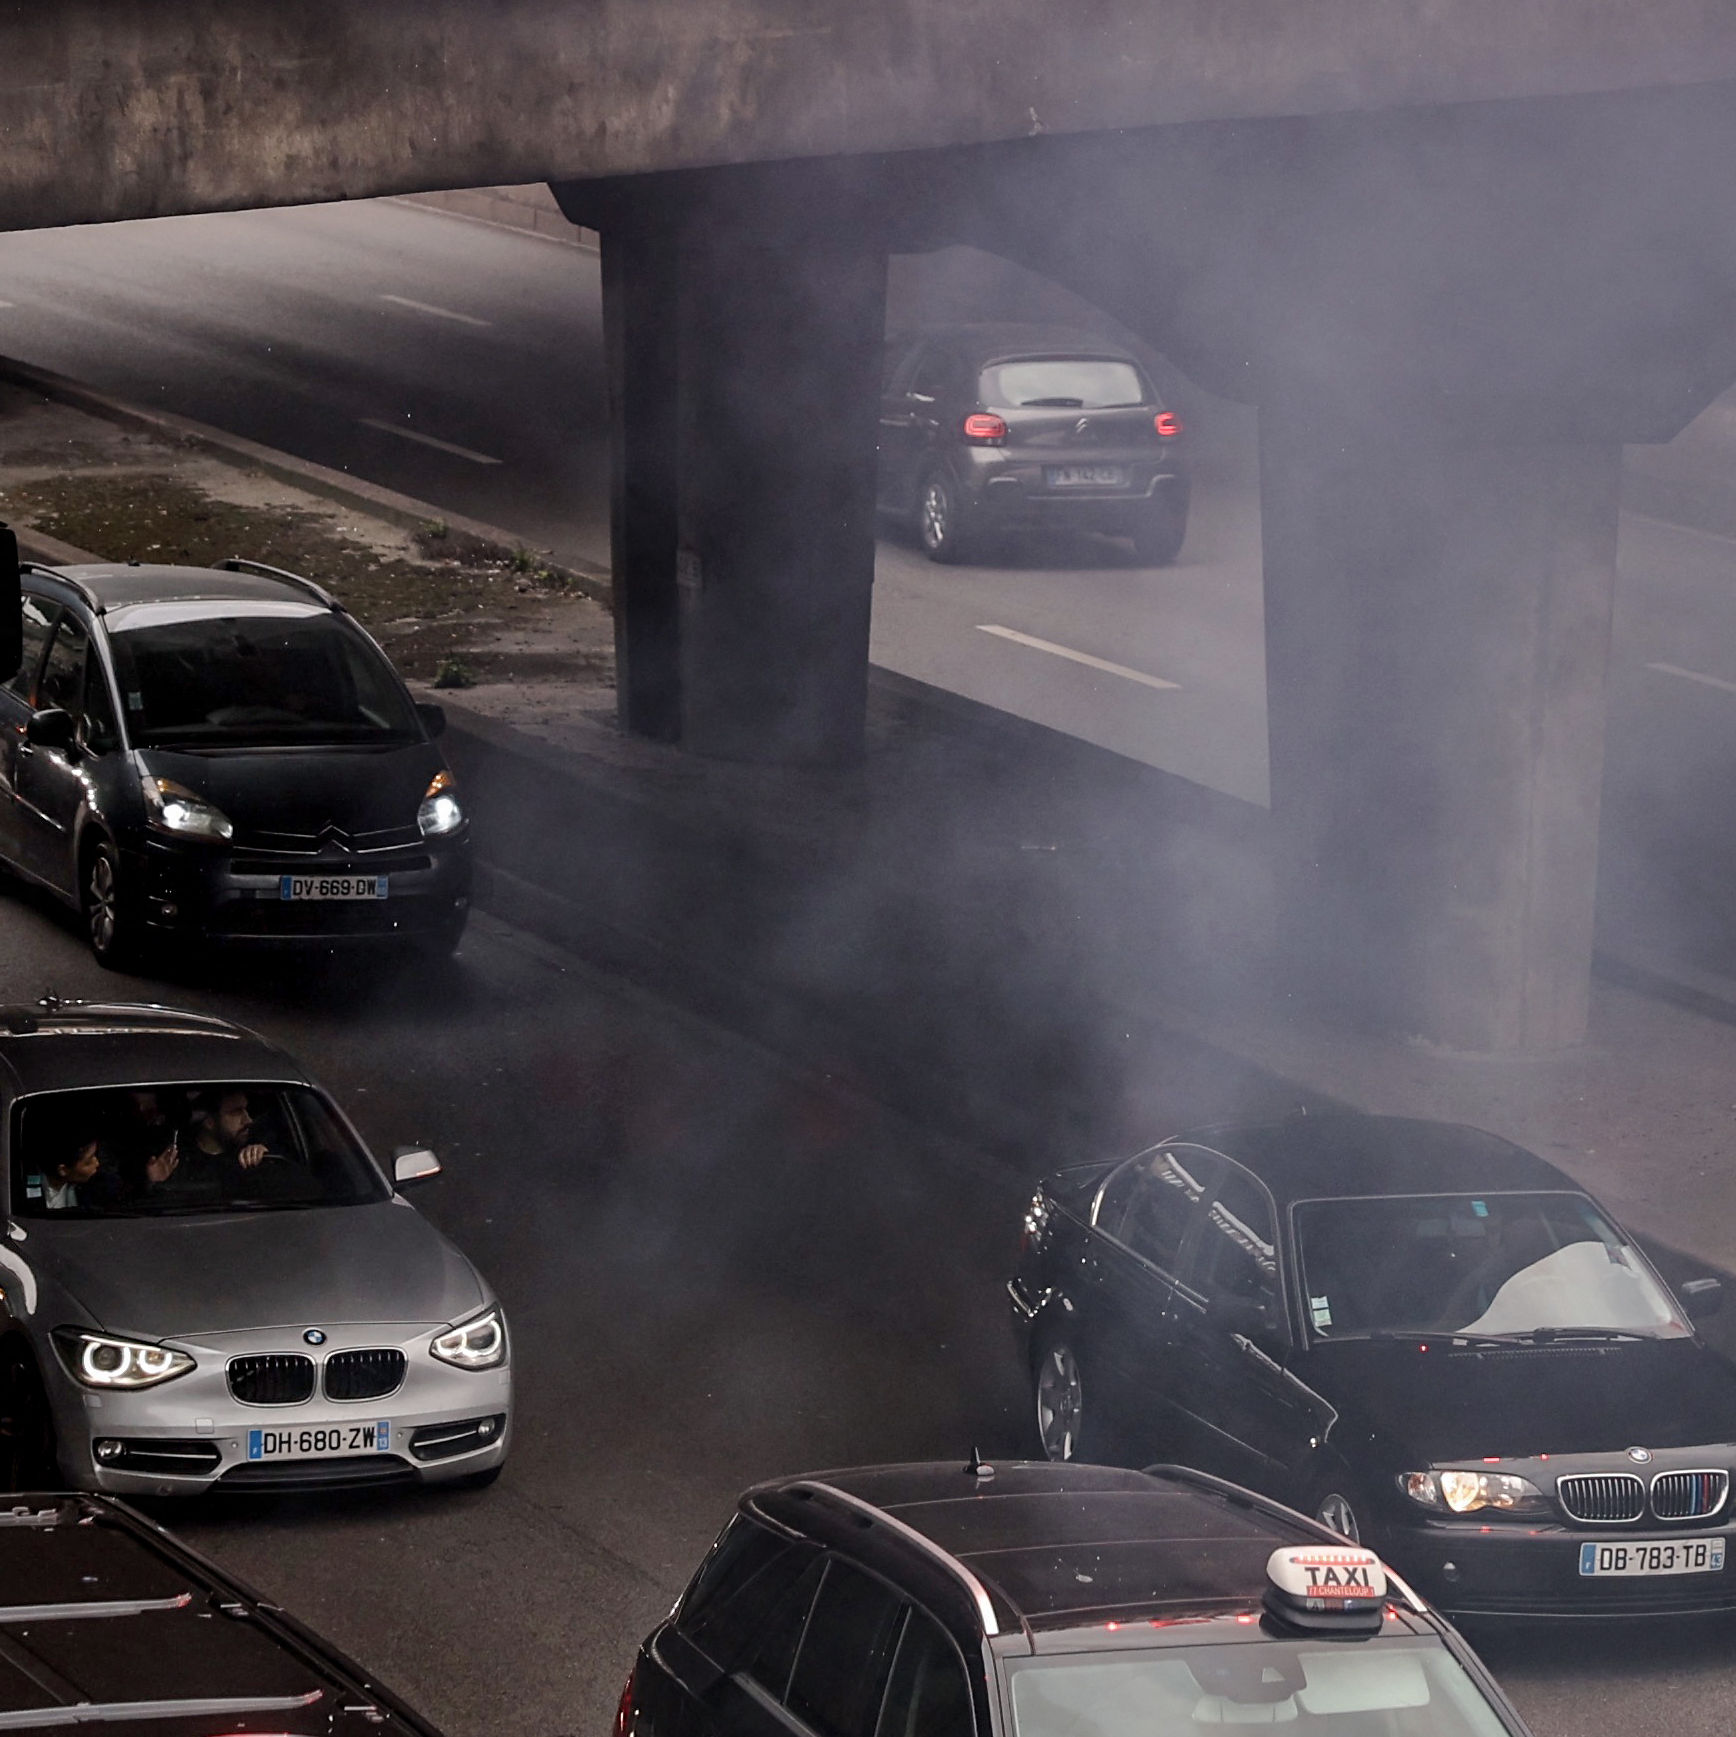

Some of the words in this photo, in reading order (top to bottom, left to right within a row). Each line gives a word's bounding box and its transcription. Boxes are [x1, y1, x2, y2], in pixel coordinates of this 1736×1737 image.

[293, 879, 377, 896] DV-669-DW
[264, 1426, 375, 1454] DH-680-ZW
[1600, 1544, 1707, 1571] DB-783-TB
[1304, 1567, 1370, 1587] TAXI
